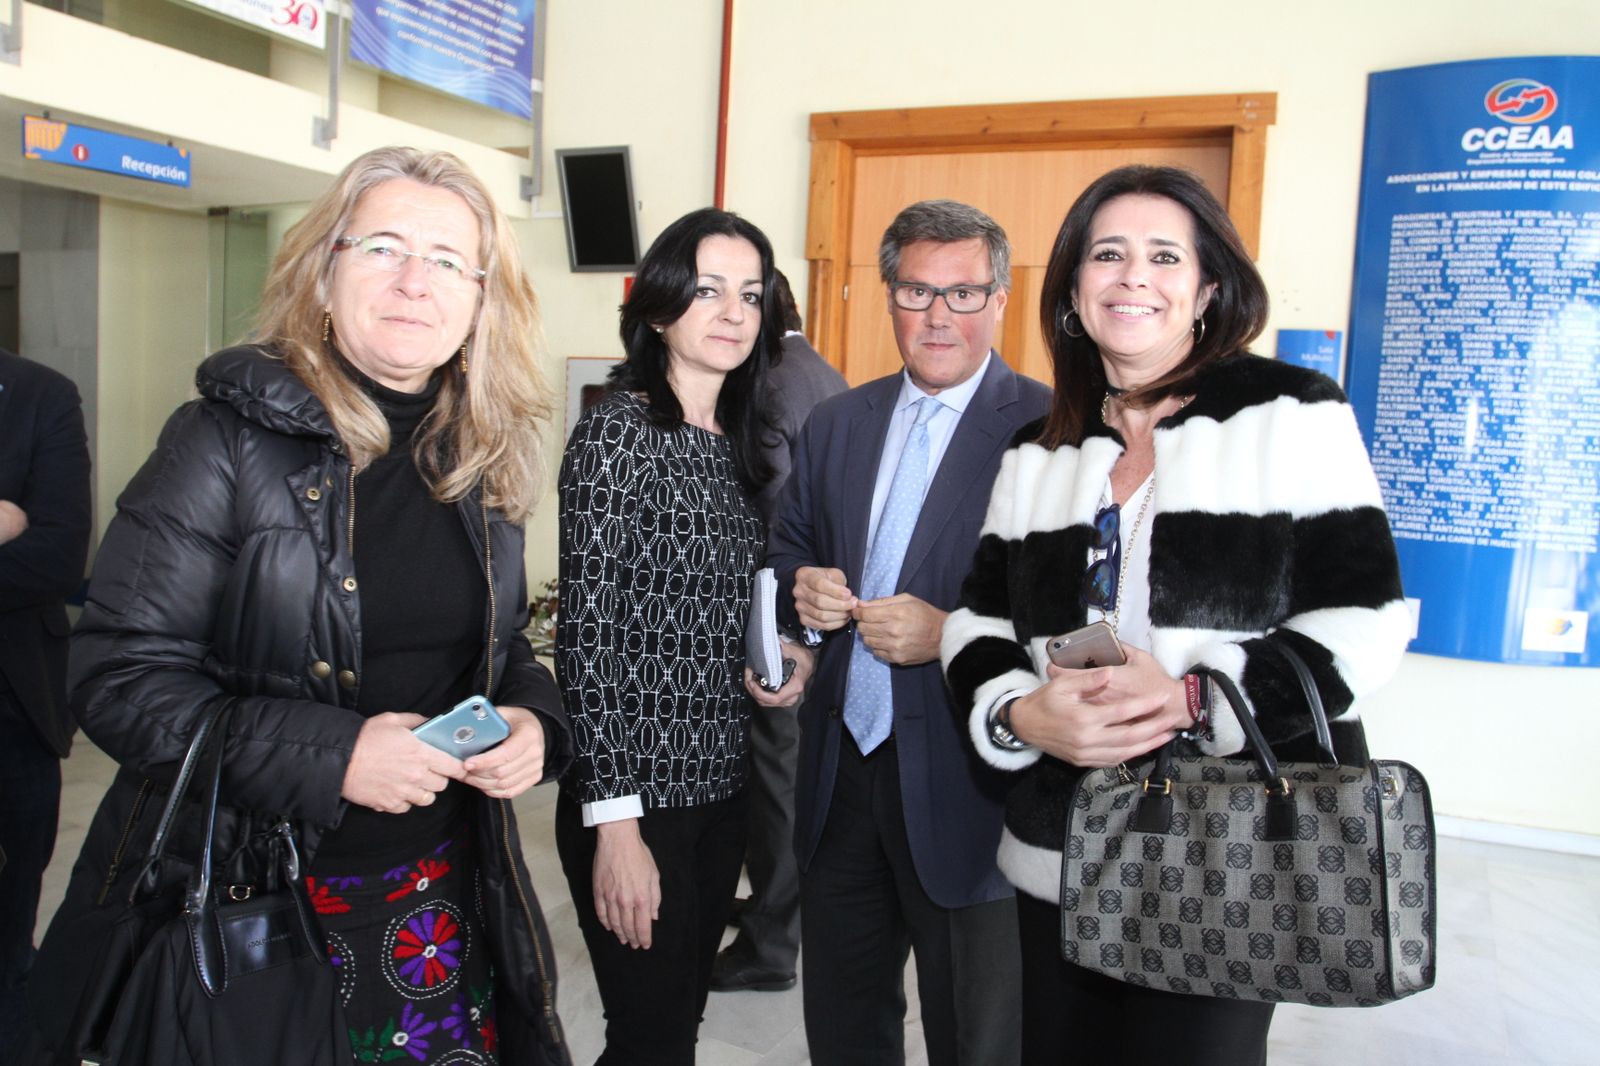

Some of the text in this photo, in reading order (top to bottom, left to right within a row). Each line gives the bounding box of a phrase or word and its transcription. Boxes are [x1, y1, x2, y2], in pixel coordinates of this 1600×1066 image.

[1461, 126, 1574, 151] CCEAA
[121, 155, 187, 182] Recepción
[1386, 171, 1459, 184] ASOCIACIONES
[1460, 170, 1469, 179] Y
[1469, 169, 1527, 180] EMPRESAS
[1528, 169, 1551, 178] QUE
[1552, 169, 1576, 179] HAN
[1415, 184, 1431, 193] EN
[1431, 183, 1447, 192] LA
[1523, 181, 1538, 190] DE
[1540, 181, 1568, 191] ESTE
